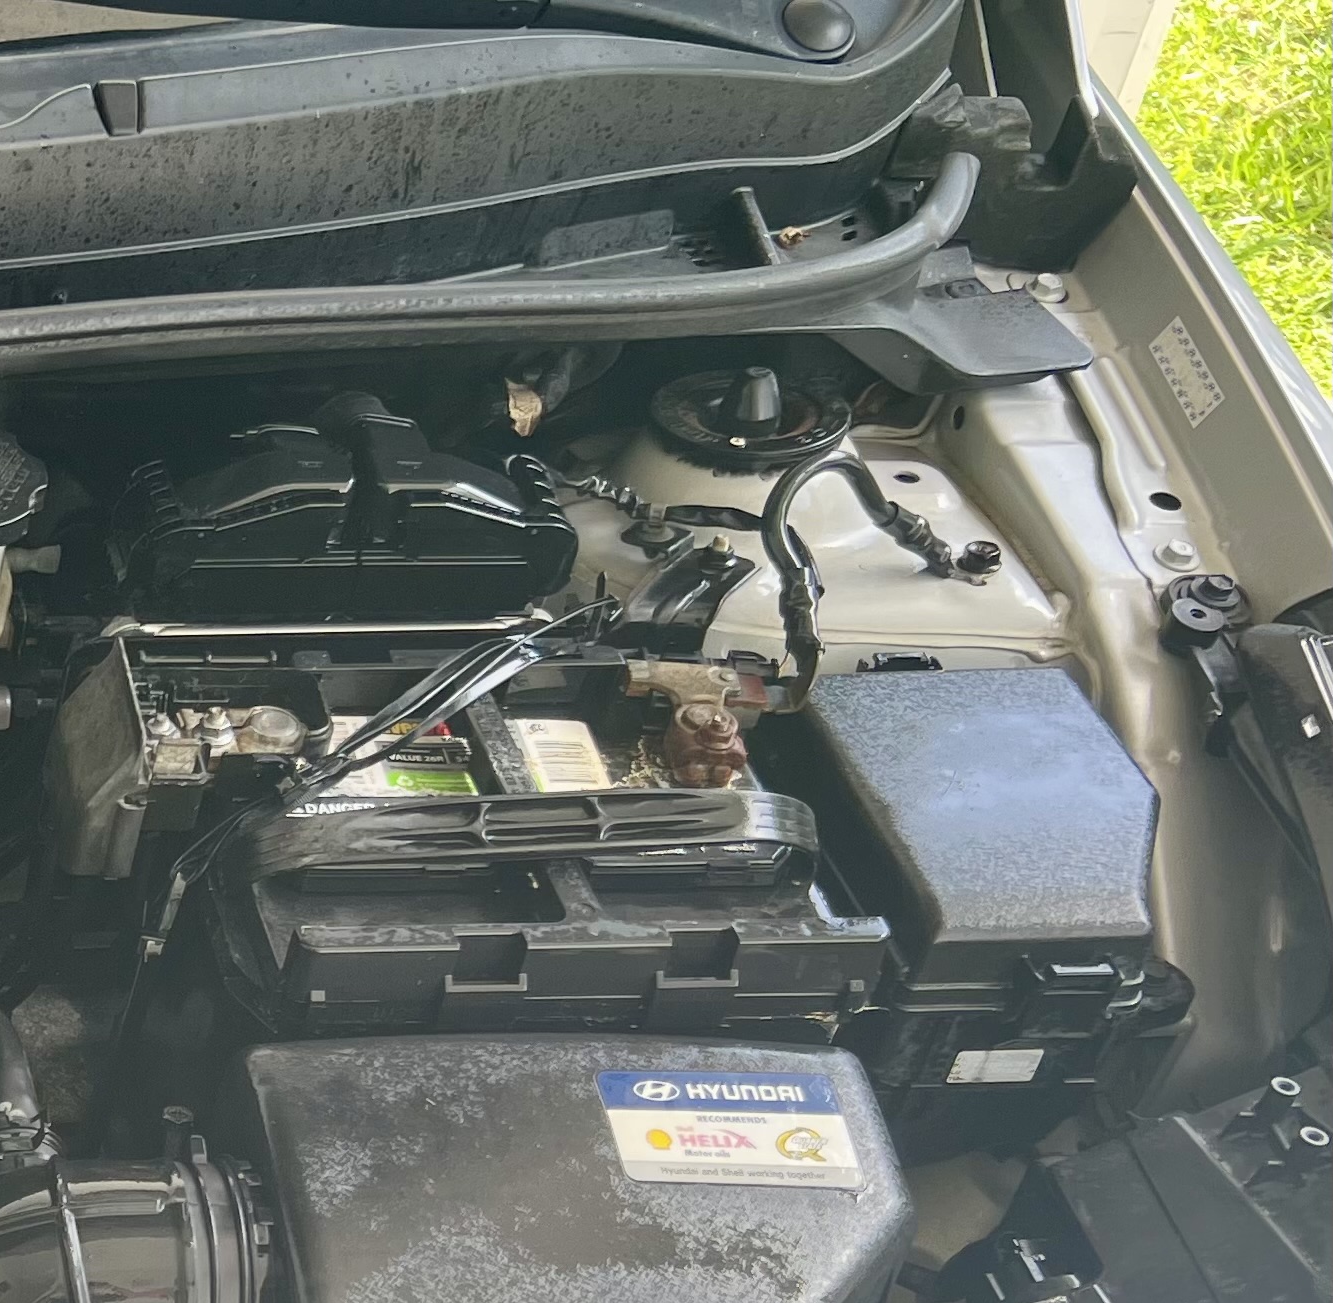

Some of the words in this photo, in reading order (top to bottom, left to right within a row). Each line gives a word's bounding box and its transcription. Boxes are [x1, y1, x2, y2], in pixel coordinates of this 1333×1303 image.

[388, 753, 423, 762] VALUE
[685, 1083, 805, 1102] HYUNDAI
[696, 1115, 767, 1125] RECOMMENDS
[678, 1133, 754, 1149] HELIX
[685, 1149, 713, 1158] Motor
[660, 1167, 699, 1176] Hyundai
[702, 1168, 719, 1177] and
[721, 1168, 744, 1177] Shell
[747, 1169, 784, 1180] working
[787, 1171, 826, 1180] together
